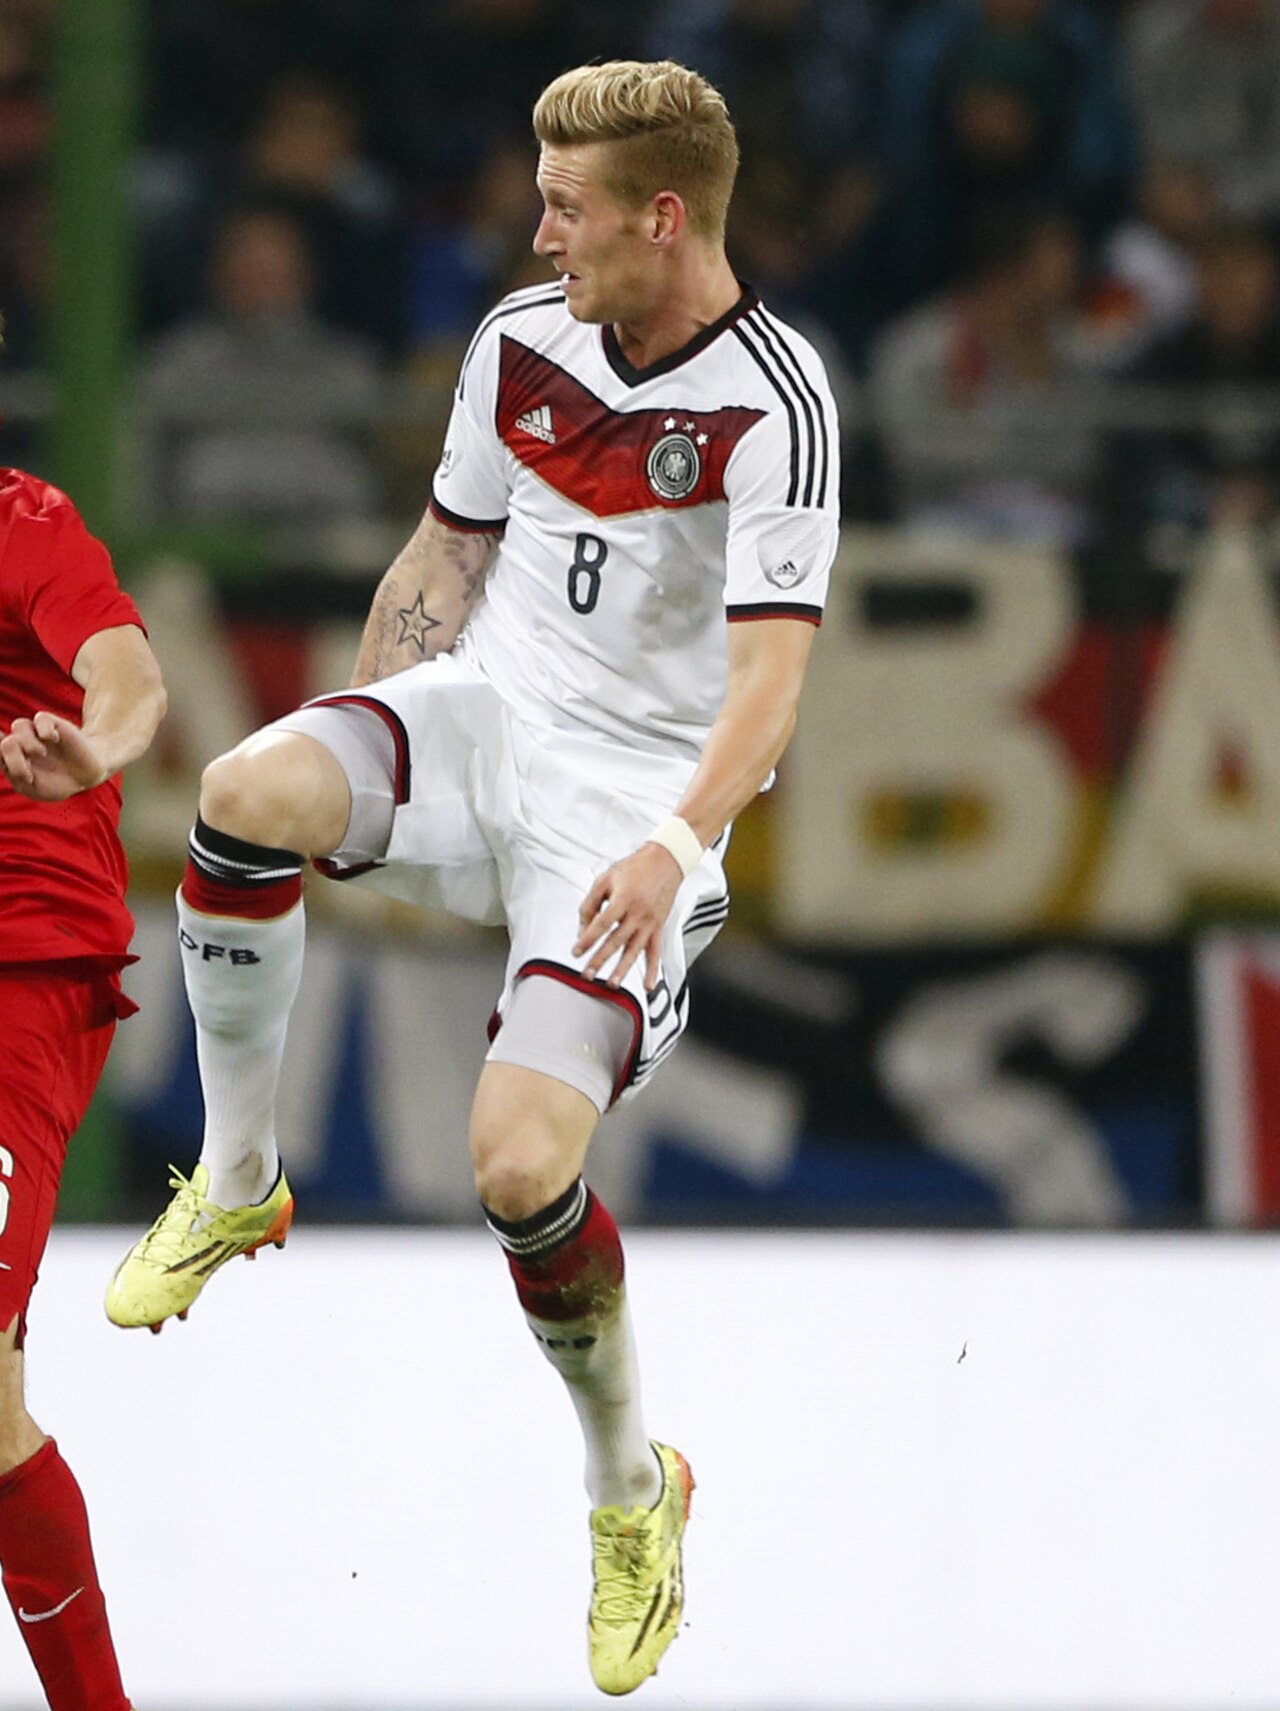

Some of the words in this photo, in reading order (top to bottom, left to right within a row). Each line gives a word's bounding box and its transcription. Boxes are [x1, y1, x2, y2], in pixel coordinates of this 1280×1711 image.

[515, 418, 556, 444] adidas
[567, 532, 609, 615] 8
[179, 928, 261, 966] DFB
